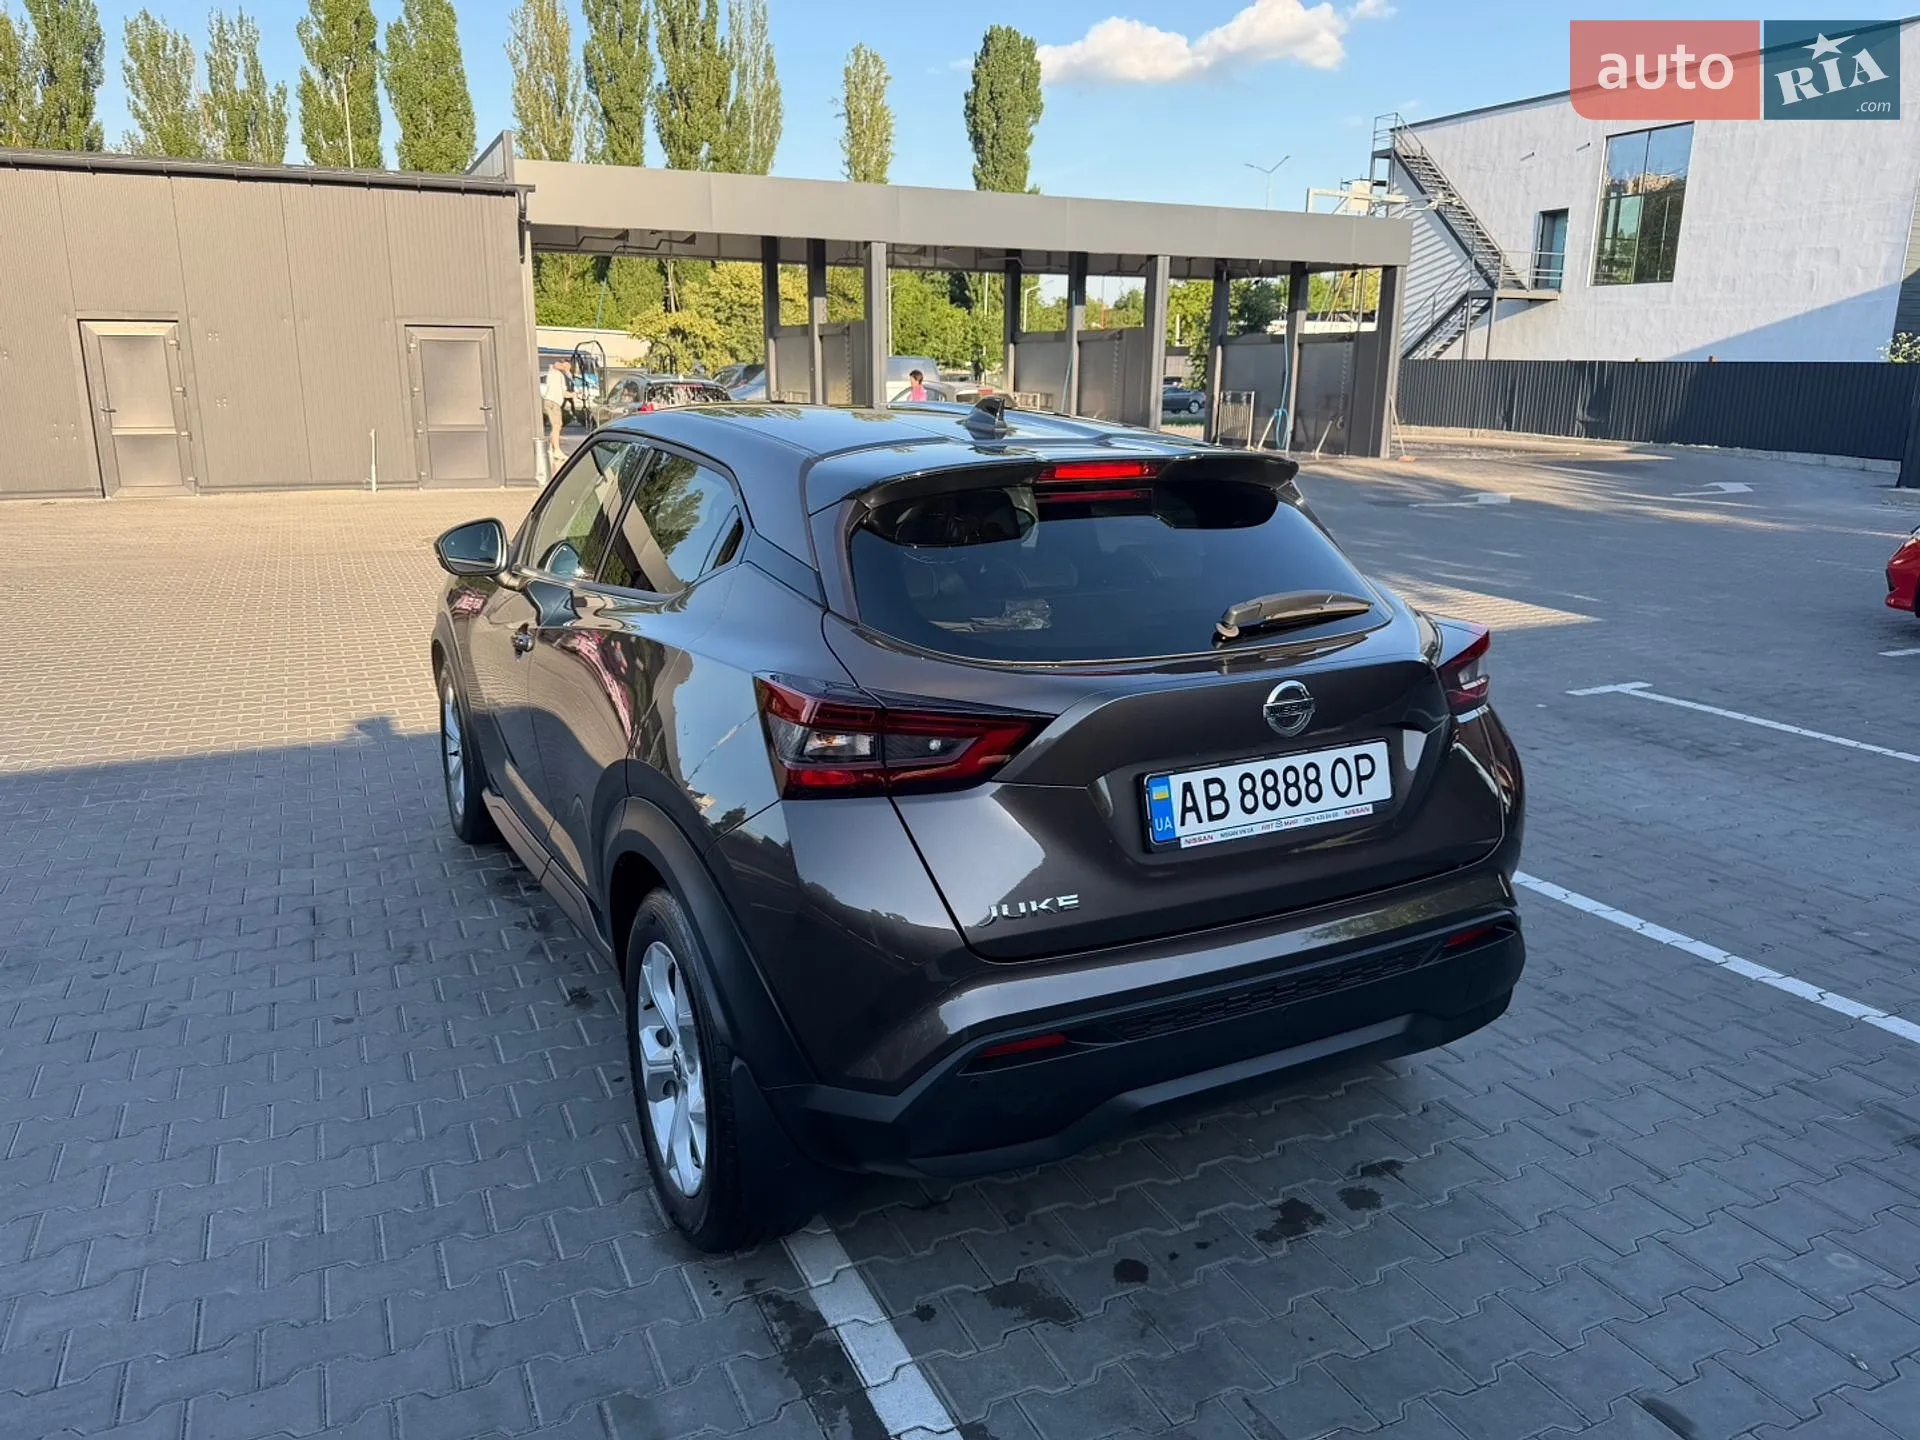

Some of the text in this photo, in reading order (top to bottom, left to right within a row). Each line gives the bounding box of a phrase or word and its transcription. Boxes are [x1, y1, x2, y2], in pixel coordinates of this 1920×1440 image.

[1179, 753, 1376, 827] AB 8888 OP
[1154, 816, 1173, 832] UA
[976, 893, 1080, 928] JUKE
